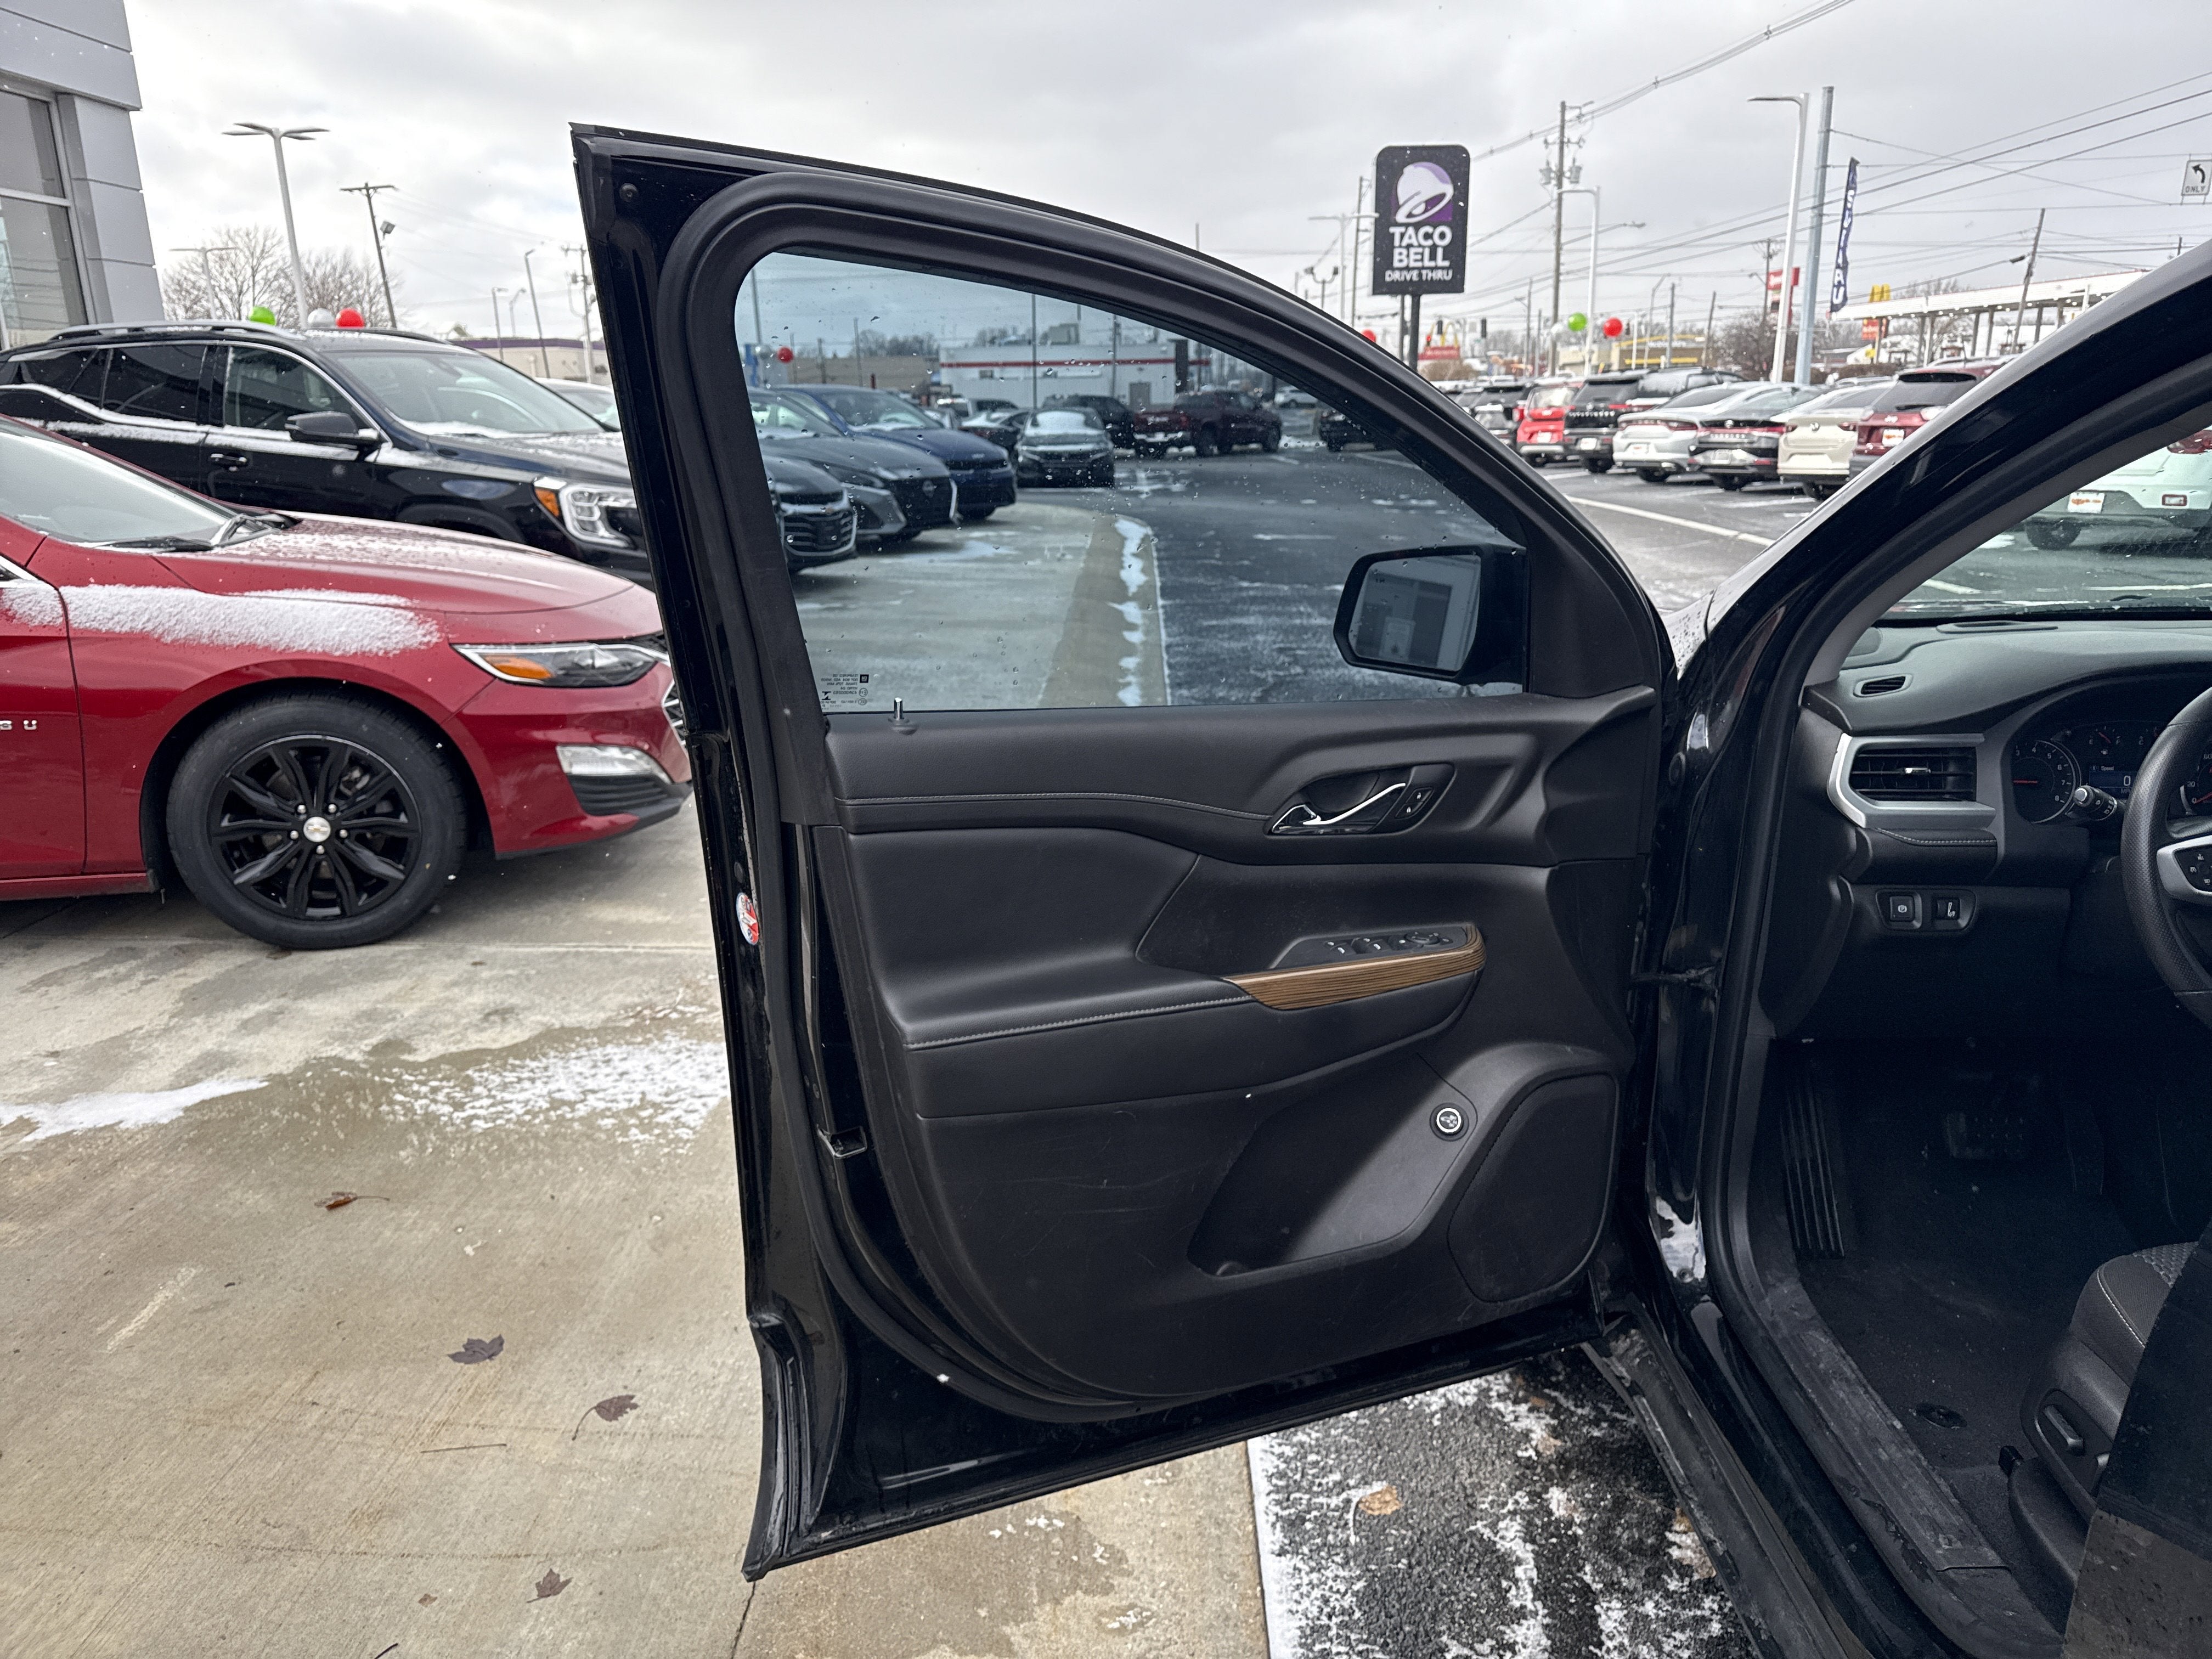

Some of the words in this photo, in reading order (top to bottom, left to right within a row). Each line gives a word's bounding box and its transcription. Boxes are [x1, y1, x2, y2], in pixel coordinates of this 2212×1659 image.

[1389, 224, 1452, 247] TACO
[1392, 247, 1451, 268] BELL
[1384, 269, 1419, 282] DRIVE
[1421, 269, 1453, 281] THRU
[2123, 775, 2131, 786] 0
